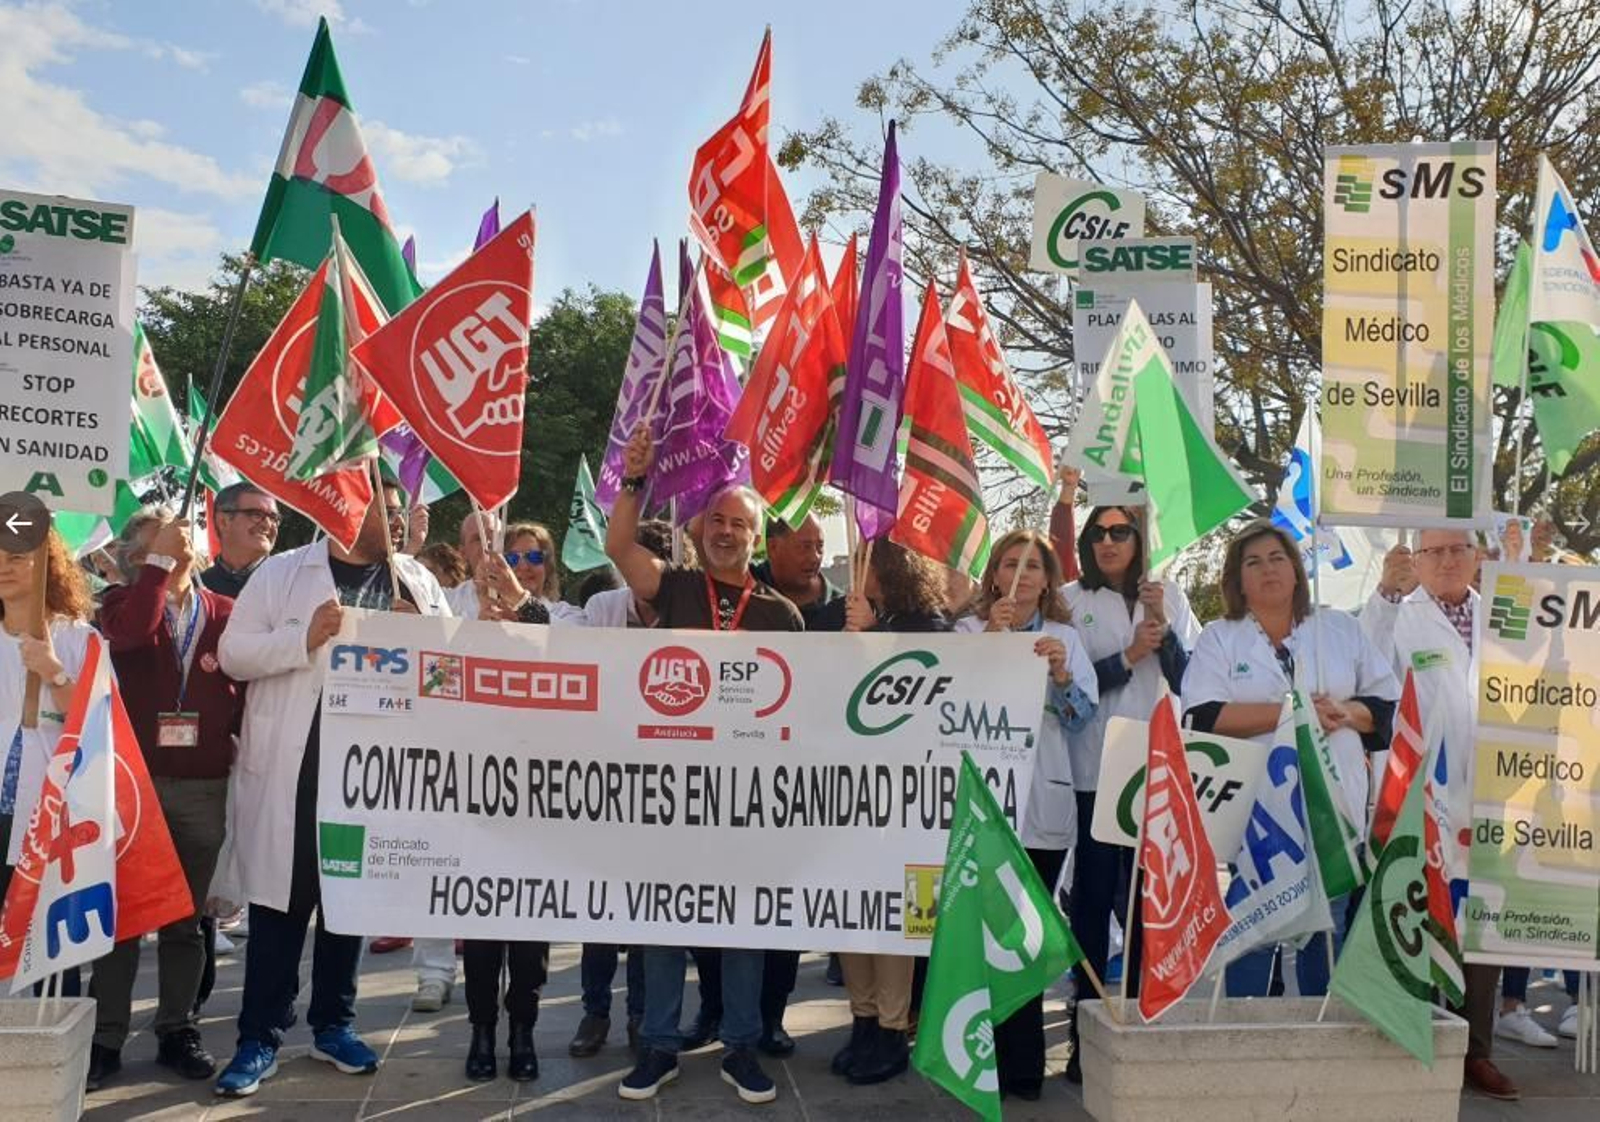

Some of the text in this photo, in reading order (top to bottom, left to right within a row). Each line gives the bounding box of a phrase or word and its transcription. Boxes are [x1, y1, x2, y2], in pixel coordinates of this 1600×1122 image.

[0, 200, 128, 245] SATSE
[1085, 244, 1193, 271] SATSE
[1332, 247, 1441, 274] Sindicato
[0, 273, 111, 298] BASTA YA DE
[1453, 246, 1471, 322] Médicos
[1178, 312, 1198, 326] AL
[1345, 316, 1430, 343] Médico
[18, 333, 111, 358] PERSONAL
[420, 291, 529, 403] UGT
[1453, 325, 1471, 353] los
[1452, 357, 1470, 381] de
[22, 374, 76, 394] STOP
[1326, 380, 1441, 408] de Sevilla
[0, 403, 99, 430] RECORTES
[1451, 383, 1470, 465] Sindicato
[16, 438, 109, 463] SANIDAD
[1325, 467, 1352, 480] Una
[1356, 482, 1441, 498] un Sindicato
[1535, 589, 1600, 629] SM
[474, 667, 587, 700] CCOO
[650, 657, 701, 686] UGT
[1485, 676, 1598, 708] Sindicato
[938, 700, 1012, 742] SMA
[1495, 744, 1585, 783] Médico
[342, 743, 1018, 832] CONTRA LOS RECORTES EN LA SANIDAD PÚBA
[369, 836, 429, 851] Sindicato
[1475, 817, 1594, 850] de Sevilla
[367, 852, 461, 868] de Enfermería
[367, 870, 400, 880] Sevilla
[428, 875, 902, 932] HOSPITAL U. VIRGEN DE VALME
[1471, 907, 1575, 928] Una Profesión,
[1503, 925, 1592, 943] un Sindicato
